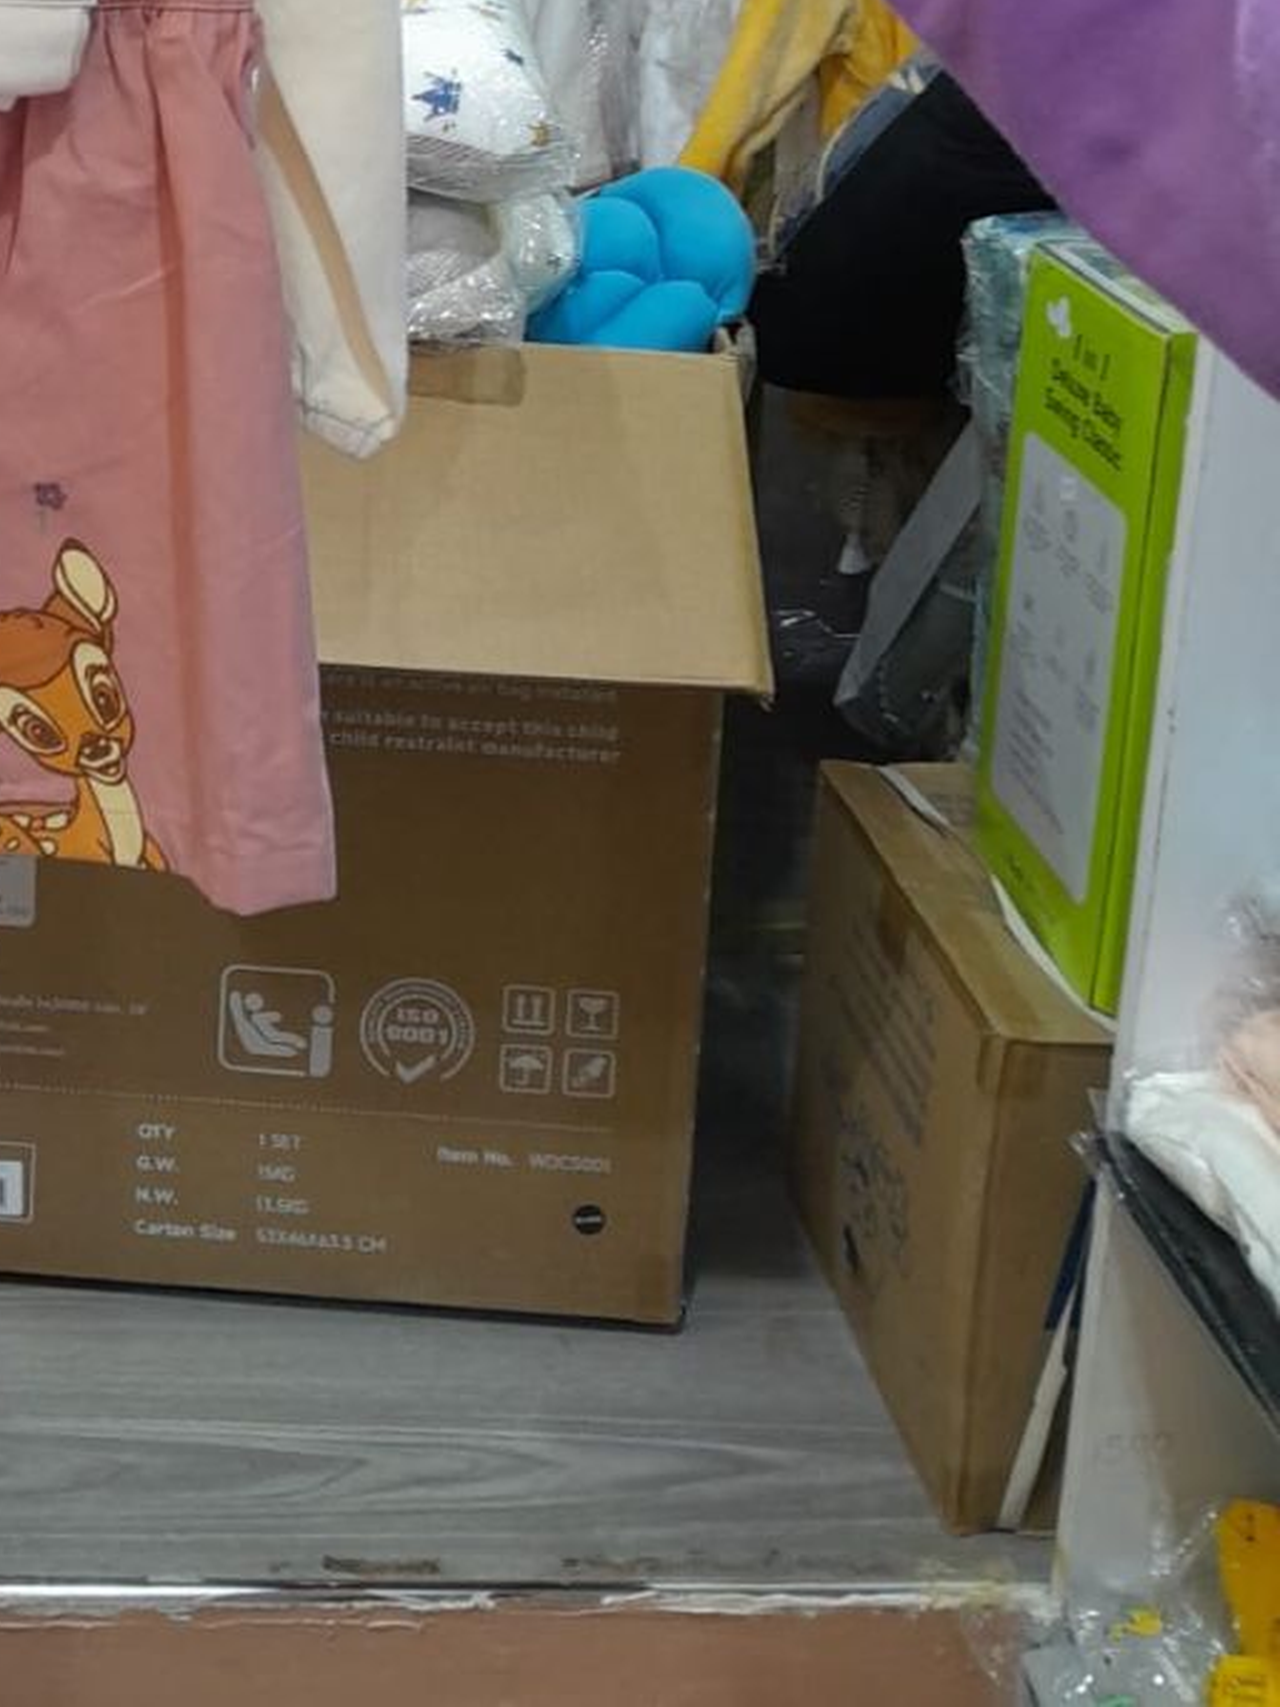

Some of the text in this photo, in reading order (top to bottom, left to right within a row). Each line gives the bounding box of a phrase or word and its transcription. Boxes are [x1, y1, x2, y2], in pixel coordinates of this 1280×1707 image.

[138, 1123, 176, 1141] QTY
[437, 1145, 479, 1163] Item
[135, 1187, 179, 1205] N.W.
[134, 1220, 195, 1238] Carton
[199, 1223, 237, 1241] Size
